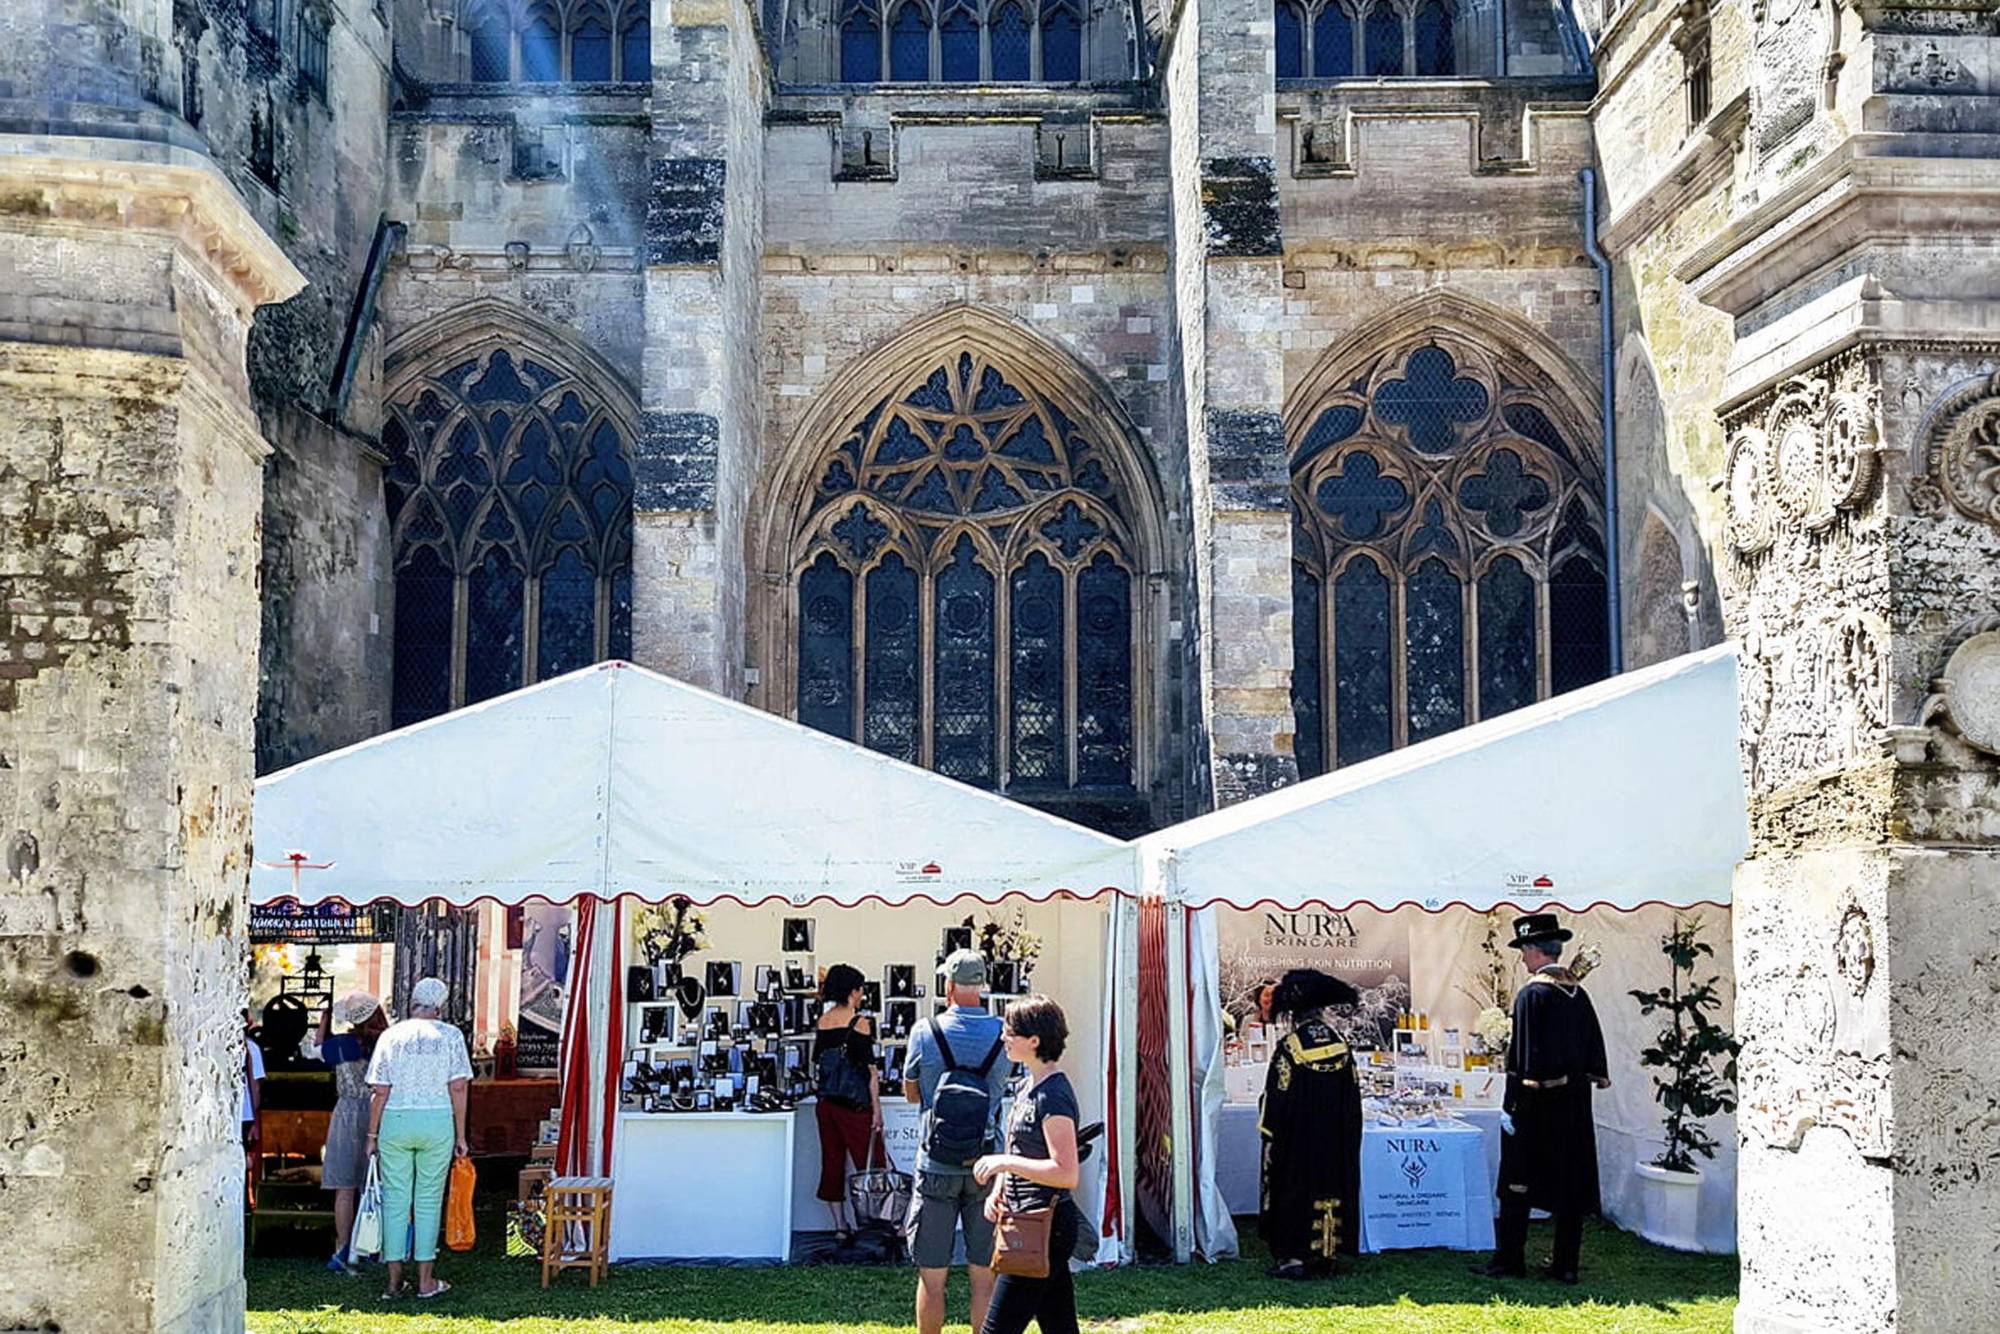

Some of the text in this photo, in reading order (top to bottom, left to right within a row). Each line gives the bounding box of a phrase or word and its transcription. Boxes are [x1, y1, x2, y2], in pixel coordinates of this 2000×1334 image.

[1510, 875, 1528, 883] VIP
[793, 894, 806, 903] 65
[1425, 898, 1439, 907] 66
[1265, 913, 1358, 937] NURA
[1264, 936, 1359, 948] SKINCARE
[1238, 956, 1392, 969] NOURISHING SKIN NUTRITION
[1387, 1139, 1439, 1153] NURA
